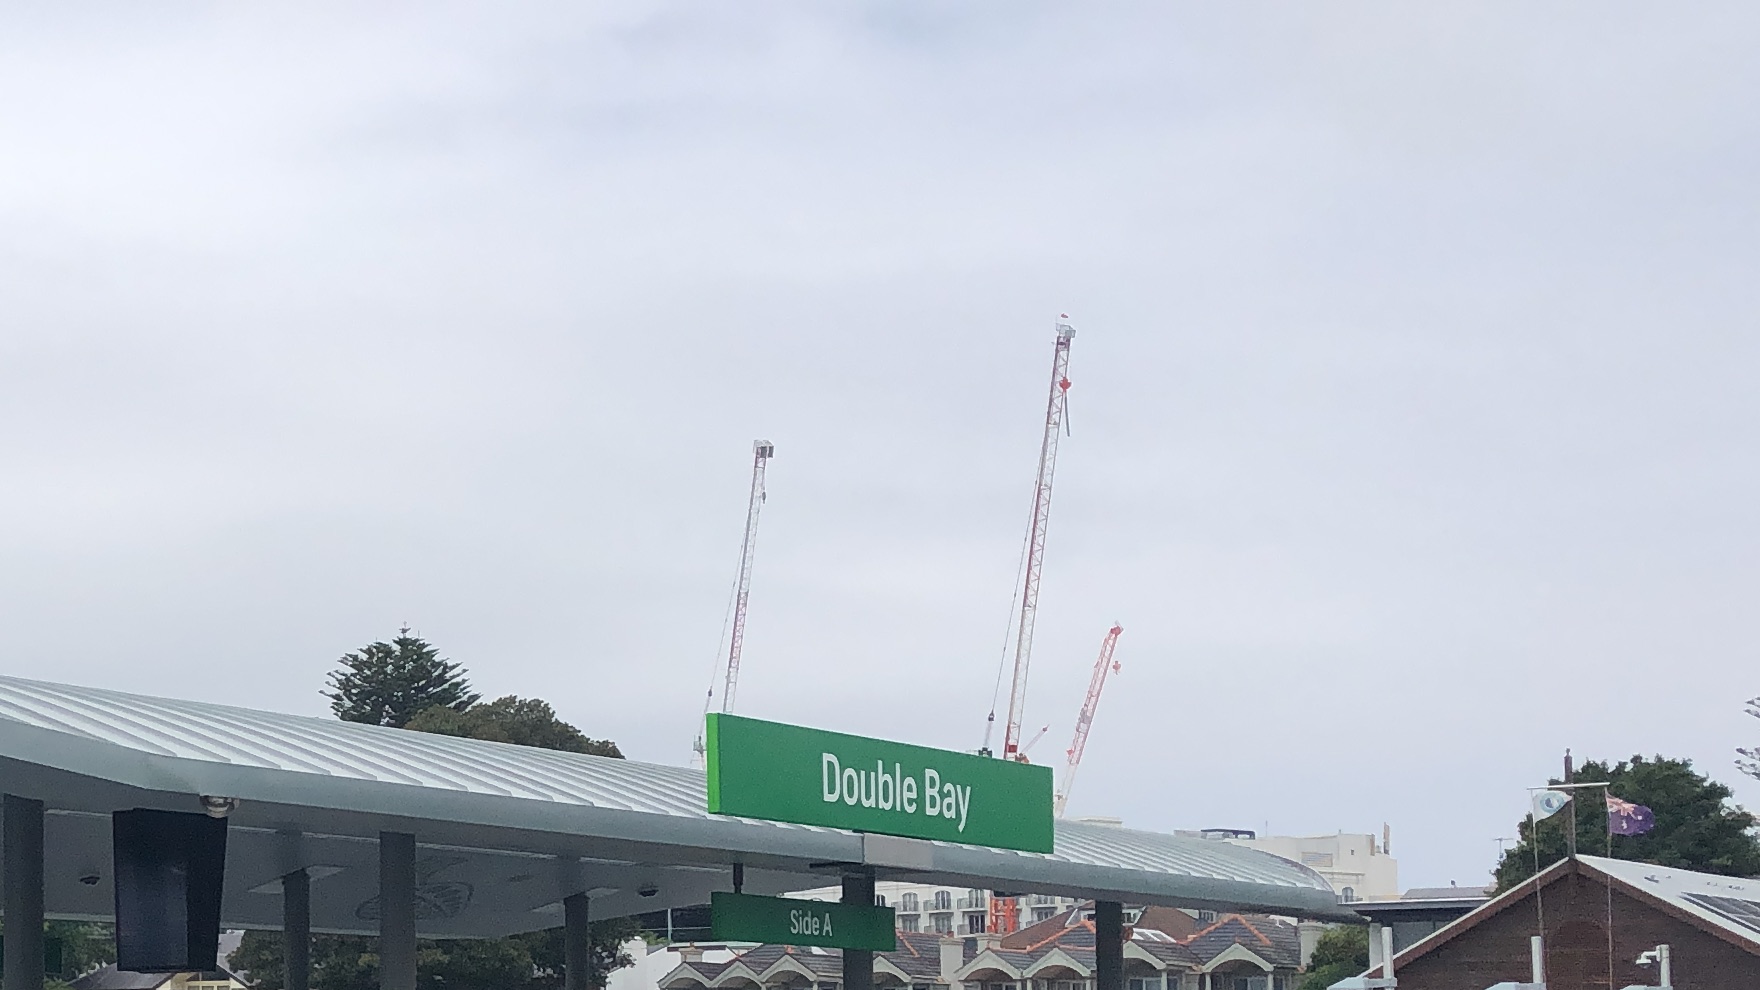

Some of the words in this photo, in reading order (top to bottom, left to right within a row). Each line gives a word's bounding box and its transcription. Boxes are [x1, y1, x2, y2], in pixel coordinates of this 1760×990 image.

[822, 752, 918, 813] Double
[924, 768, 972, 833] Bay
[790, 909, 820, 936] Side
[822, 912, 833, 937] A
